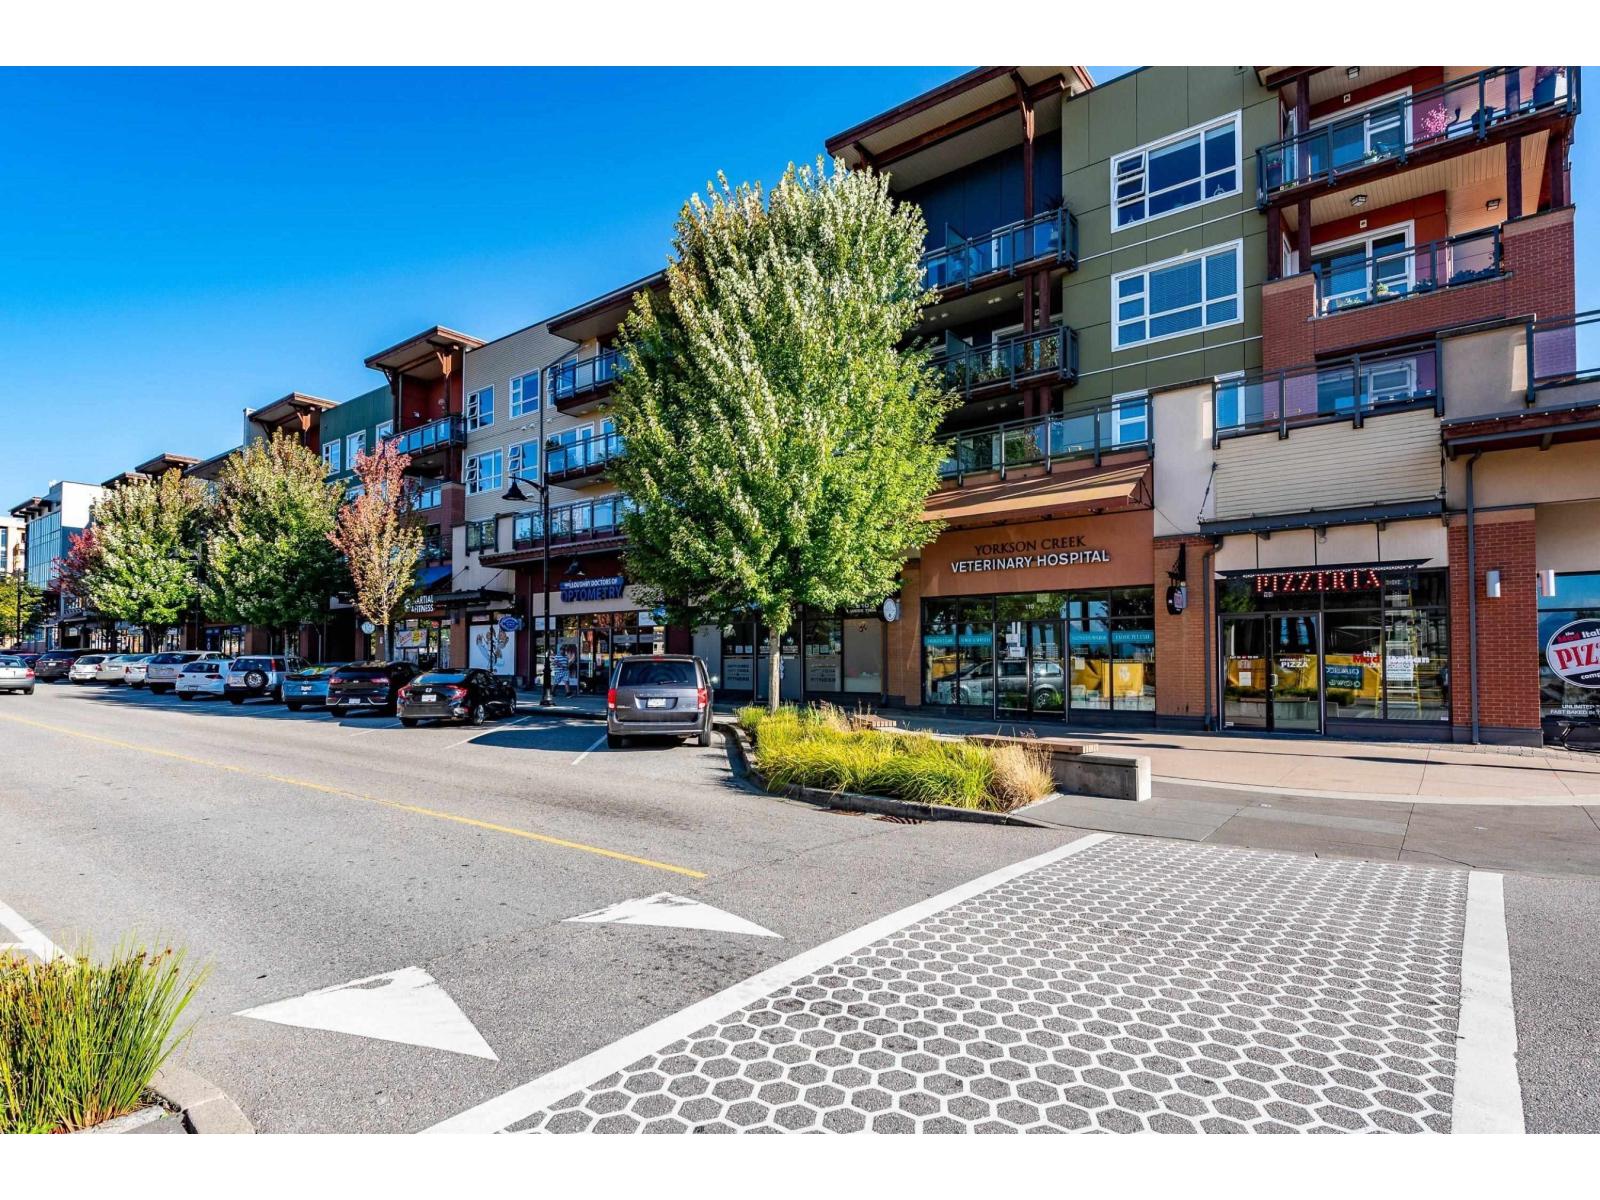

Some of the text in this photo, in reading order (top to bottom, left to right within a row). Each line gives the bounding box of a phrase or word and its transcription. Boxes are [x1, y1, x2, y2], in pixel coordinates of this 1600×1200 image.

[974, 535, 1086, 556] YORKSON CREEK
[951, 549, 1110, 573] VETERINARY HOSPITAL
[1255, 570, 1381, 593] PIZZERIA
[561, 585, 623, 602] OPTOMETRY
[1353, 655, 1380, 664] Mad
